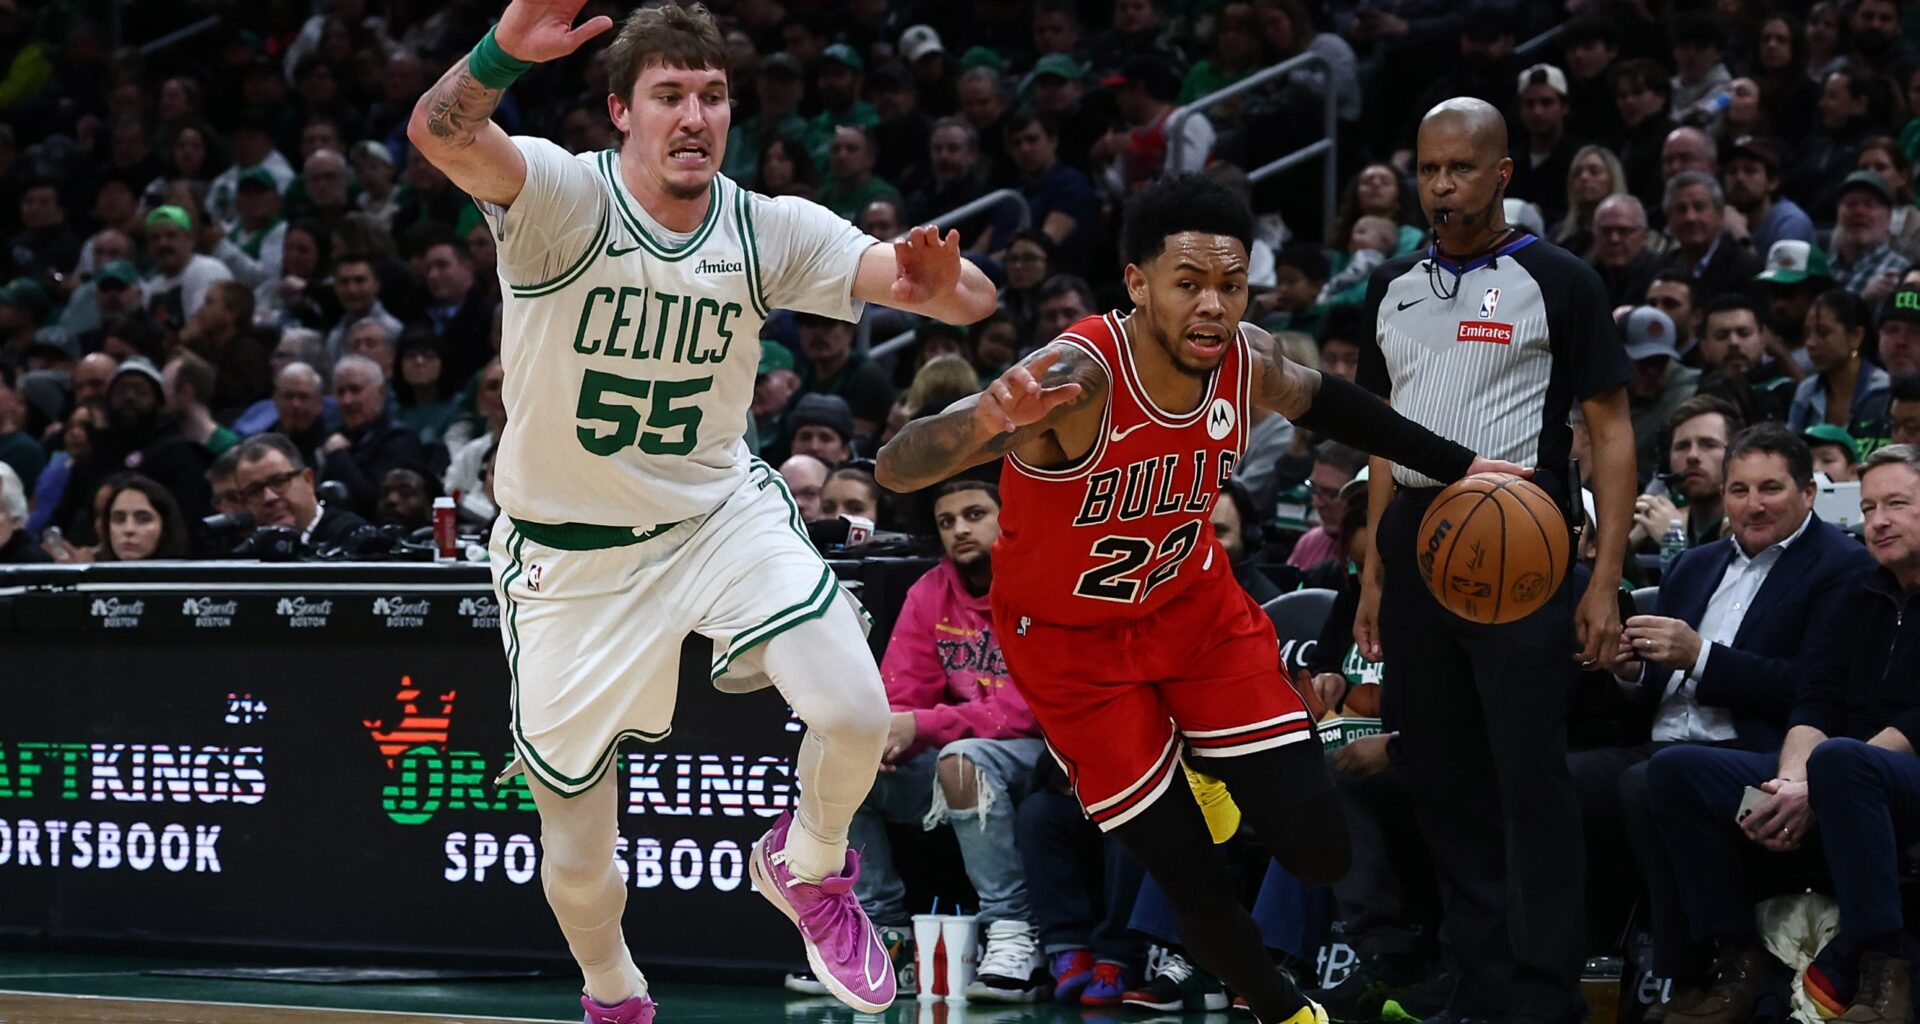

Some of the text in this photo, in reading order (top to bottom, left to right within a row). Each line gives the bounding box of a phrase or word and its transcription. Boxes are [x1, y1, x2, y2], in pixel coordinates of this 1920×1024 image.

[694, 259, 743, 275] Amica
[573, 286, 743, 365] CELTICS
[1459, 325, 1512, 340] Emirates
[576, 368, 714, 457] 55
[1072, 519, 1203, 605] 22
[104, 617, 138, 628] BOSTON
[195, 617, 231, 628] BOSTON
[290, 617, 326, 628] BOSTON
[386, 617, 424, 628] BOSTON
[225, 693, 267, 724] 21+
[0, 742, 266, 804] FTKINGS
